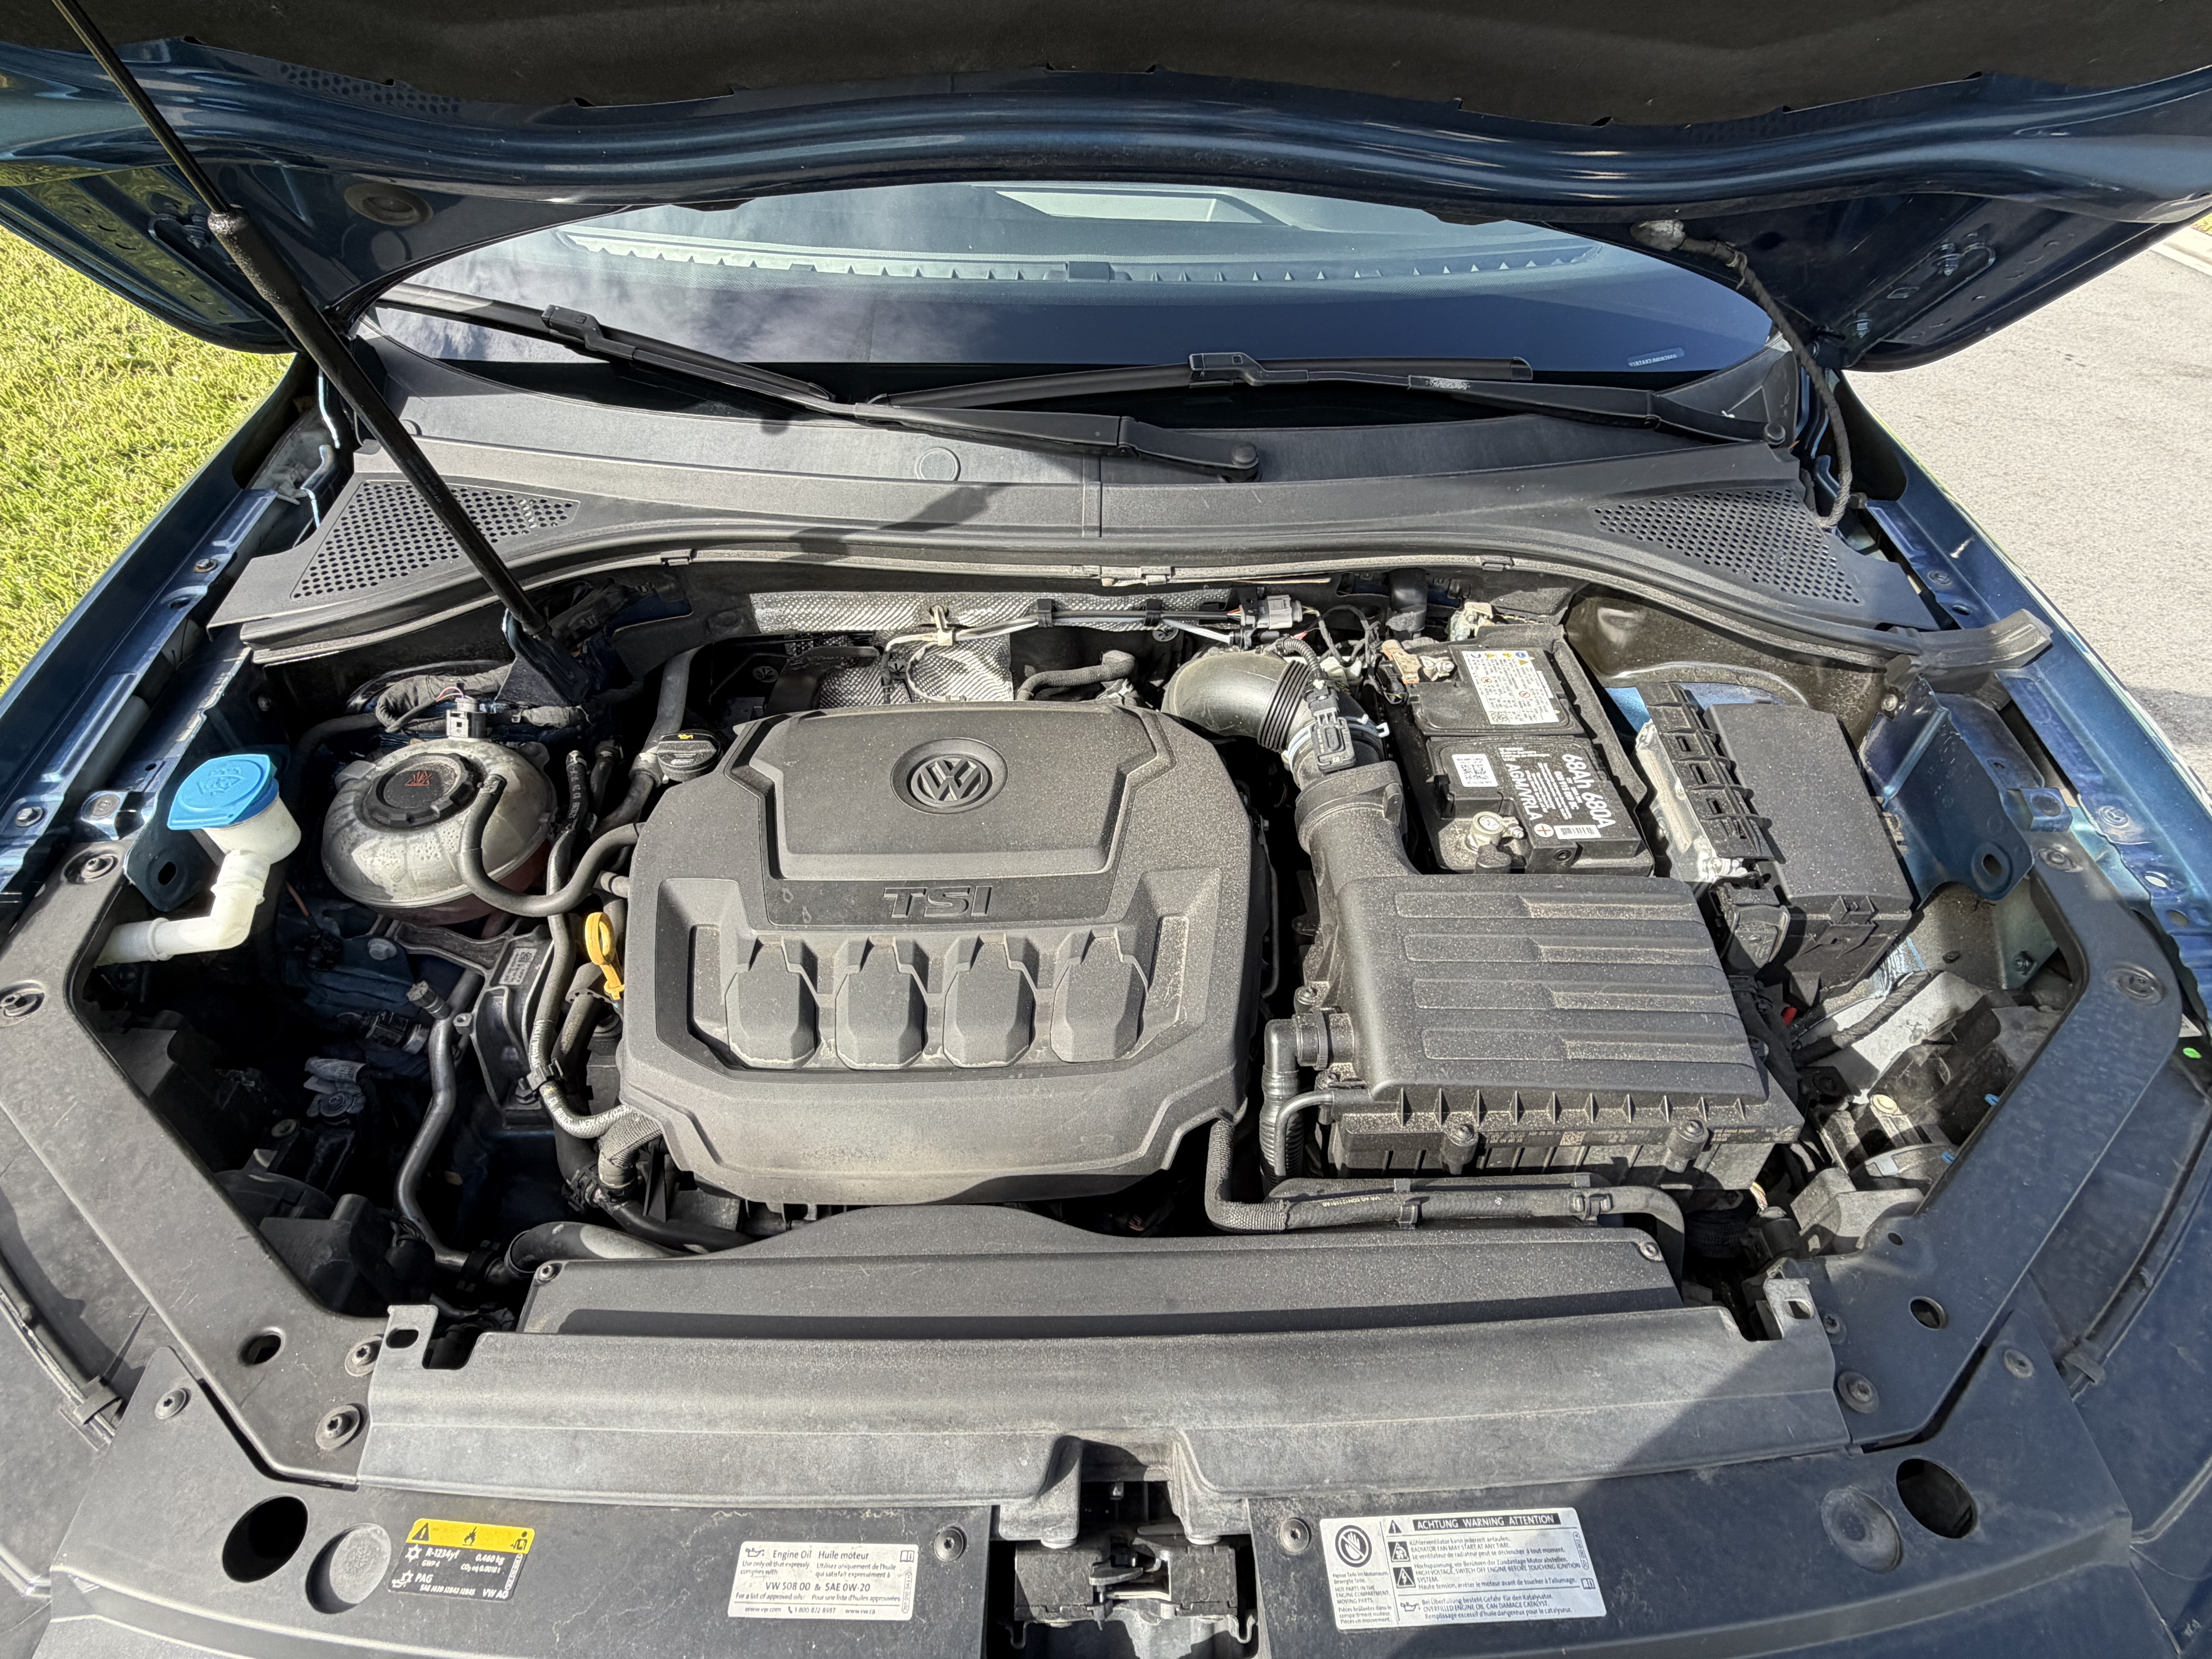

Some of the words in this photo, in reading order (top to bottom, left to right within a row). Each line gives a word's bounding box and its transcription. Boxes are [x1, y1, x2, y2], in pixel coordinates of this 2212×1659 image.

[1559, 781, 1570, 790] 915
[1505, 764, 1543, 821] AGM/VRLA
[1562, 754, 1594, 788] 68Ah
[1582, 792, 1616, 828] 680A
[883, 886, 993, 918] TSI
[1418, 1519, 1458, 1529] ACHTUNG
[1463, 1517, 1504, 1527] WARNING
[1510, 1515, 1554, 1525] ATTENTION
[426, 1547, 460, 1561] R-1234yf
[495, 1555, 505, 1566] kg
[773, 1550, 799, 1561] Engine
[801, 1550, 812, 1559] Oil
[818, 1550, 838, 1559] Huile
[841, 1551, 869, 1559] moteur
[753, 1560, 765, 1568] only
[785, 1561, 810, 1570] expressly
[415, 1573, 434, 1583] PAG
[766, 1582, 780, 1590] VW
[782, 1582, 797, 1590] 508
[800, 1582, 811, 1590] 00
[825, 1583, 841, 1591] SAE
[483, 1589, 496, 1598] VW
[495, 1590, 509, 1599] AG
